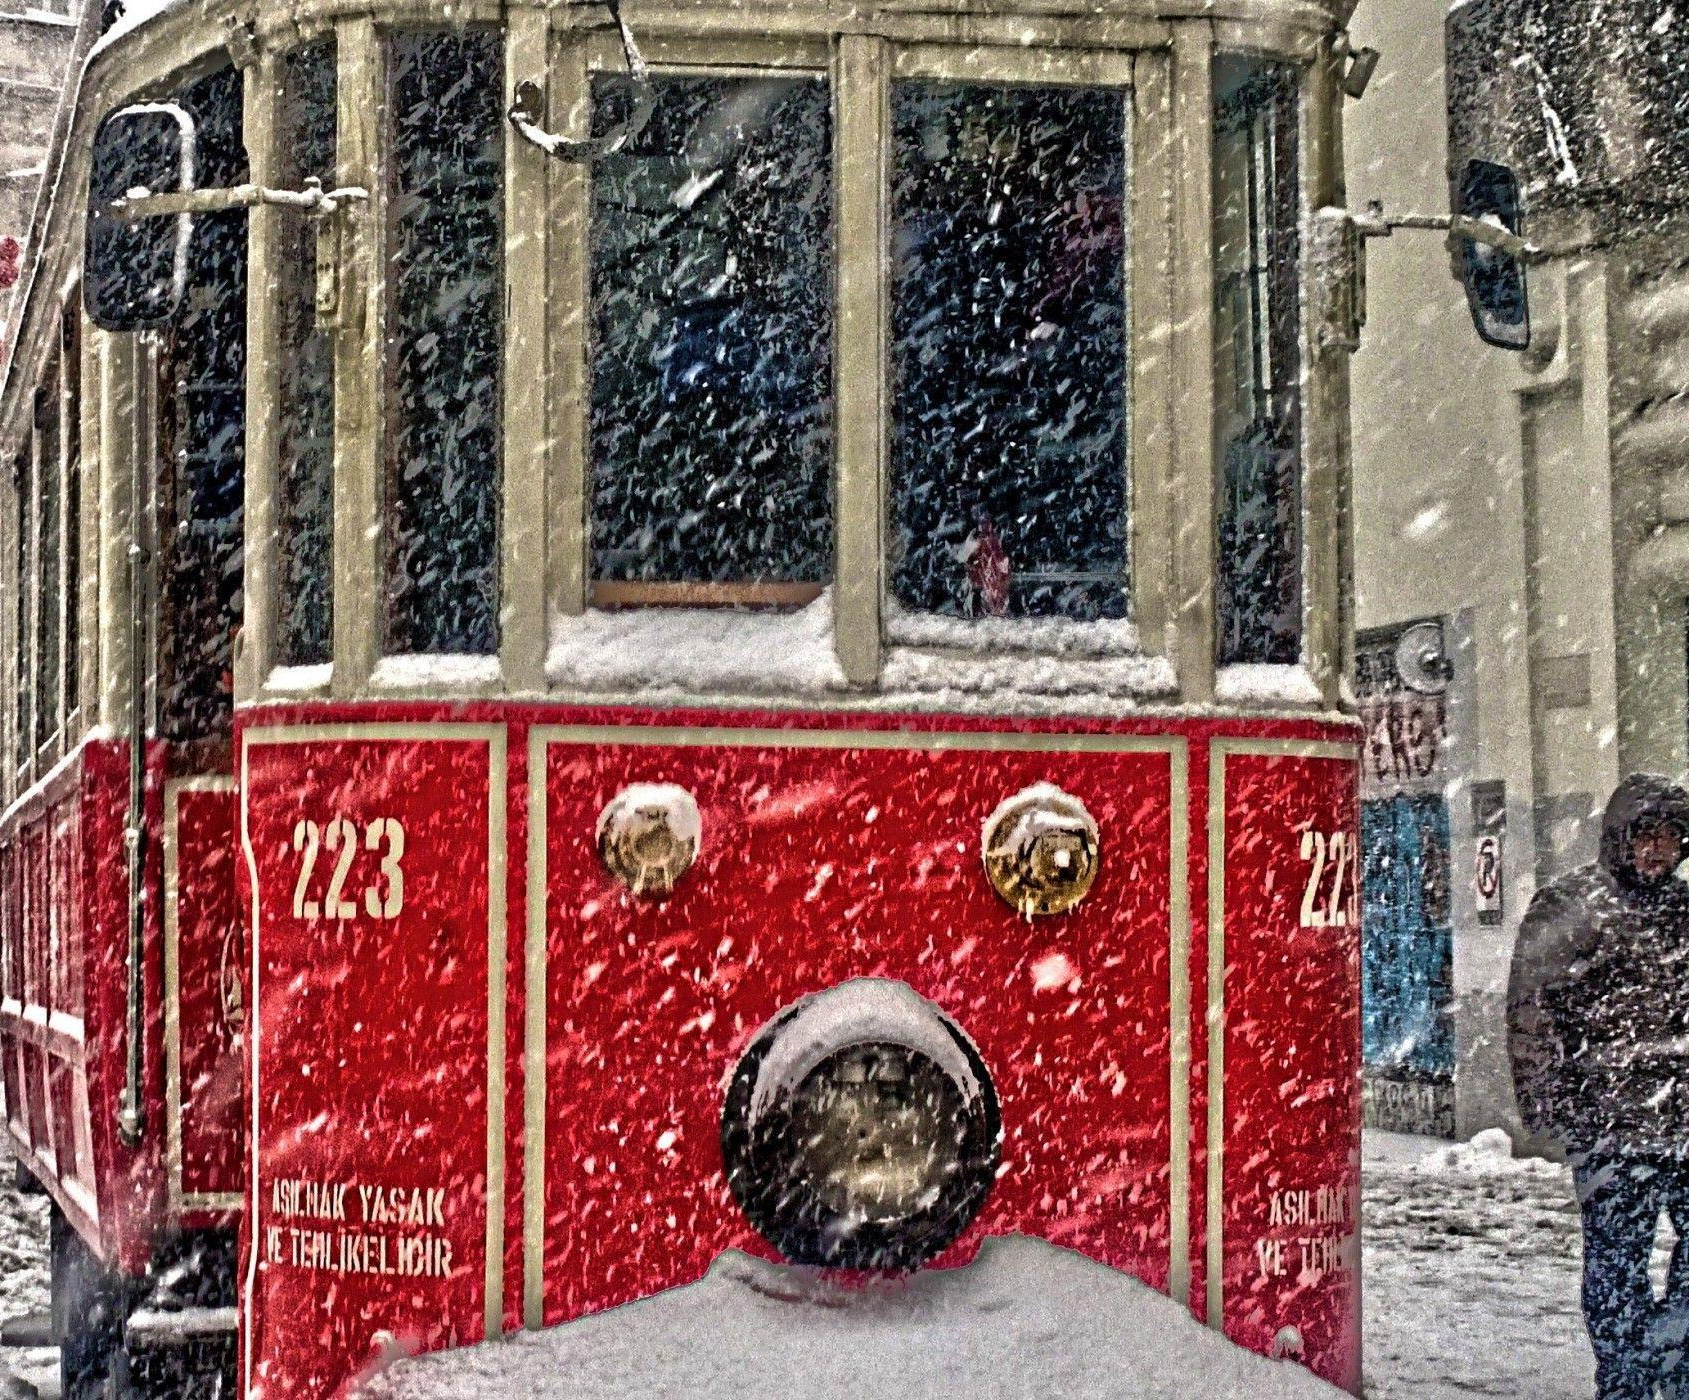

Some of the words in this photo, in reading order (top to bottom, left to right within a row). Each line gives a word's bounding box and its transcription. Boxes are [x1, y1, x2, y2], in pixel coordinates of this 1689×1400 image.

[293, 816, 405, 920] 223
[272, 1177, 346, 1222] ASILMAK
[359, 1184, 446, 1227] YASAK
[267, 1224, 284, 1264] VE
[1256, 1237, 1288, 1276] VE
